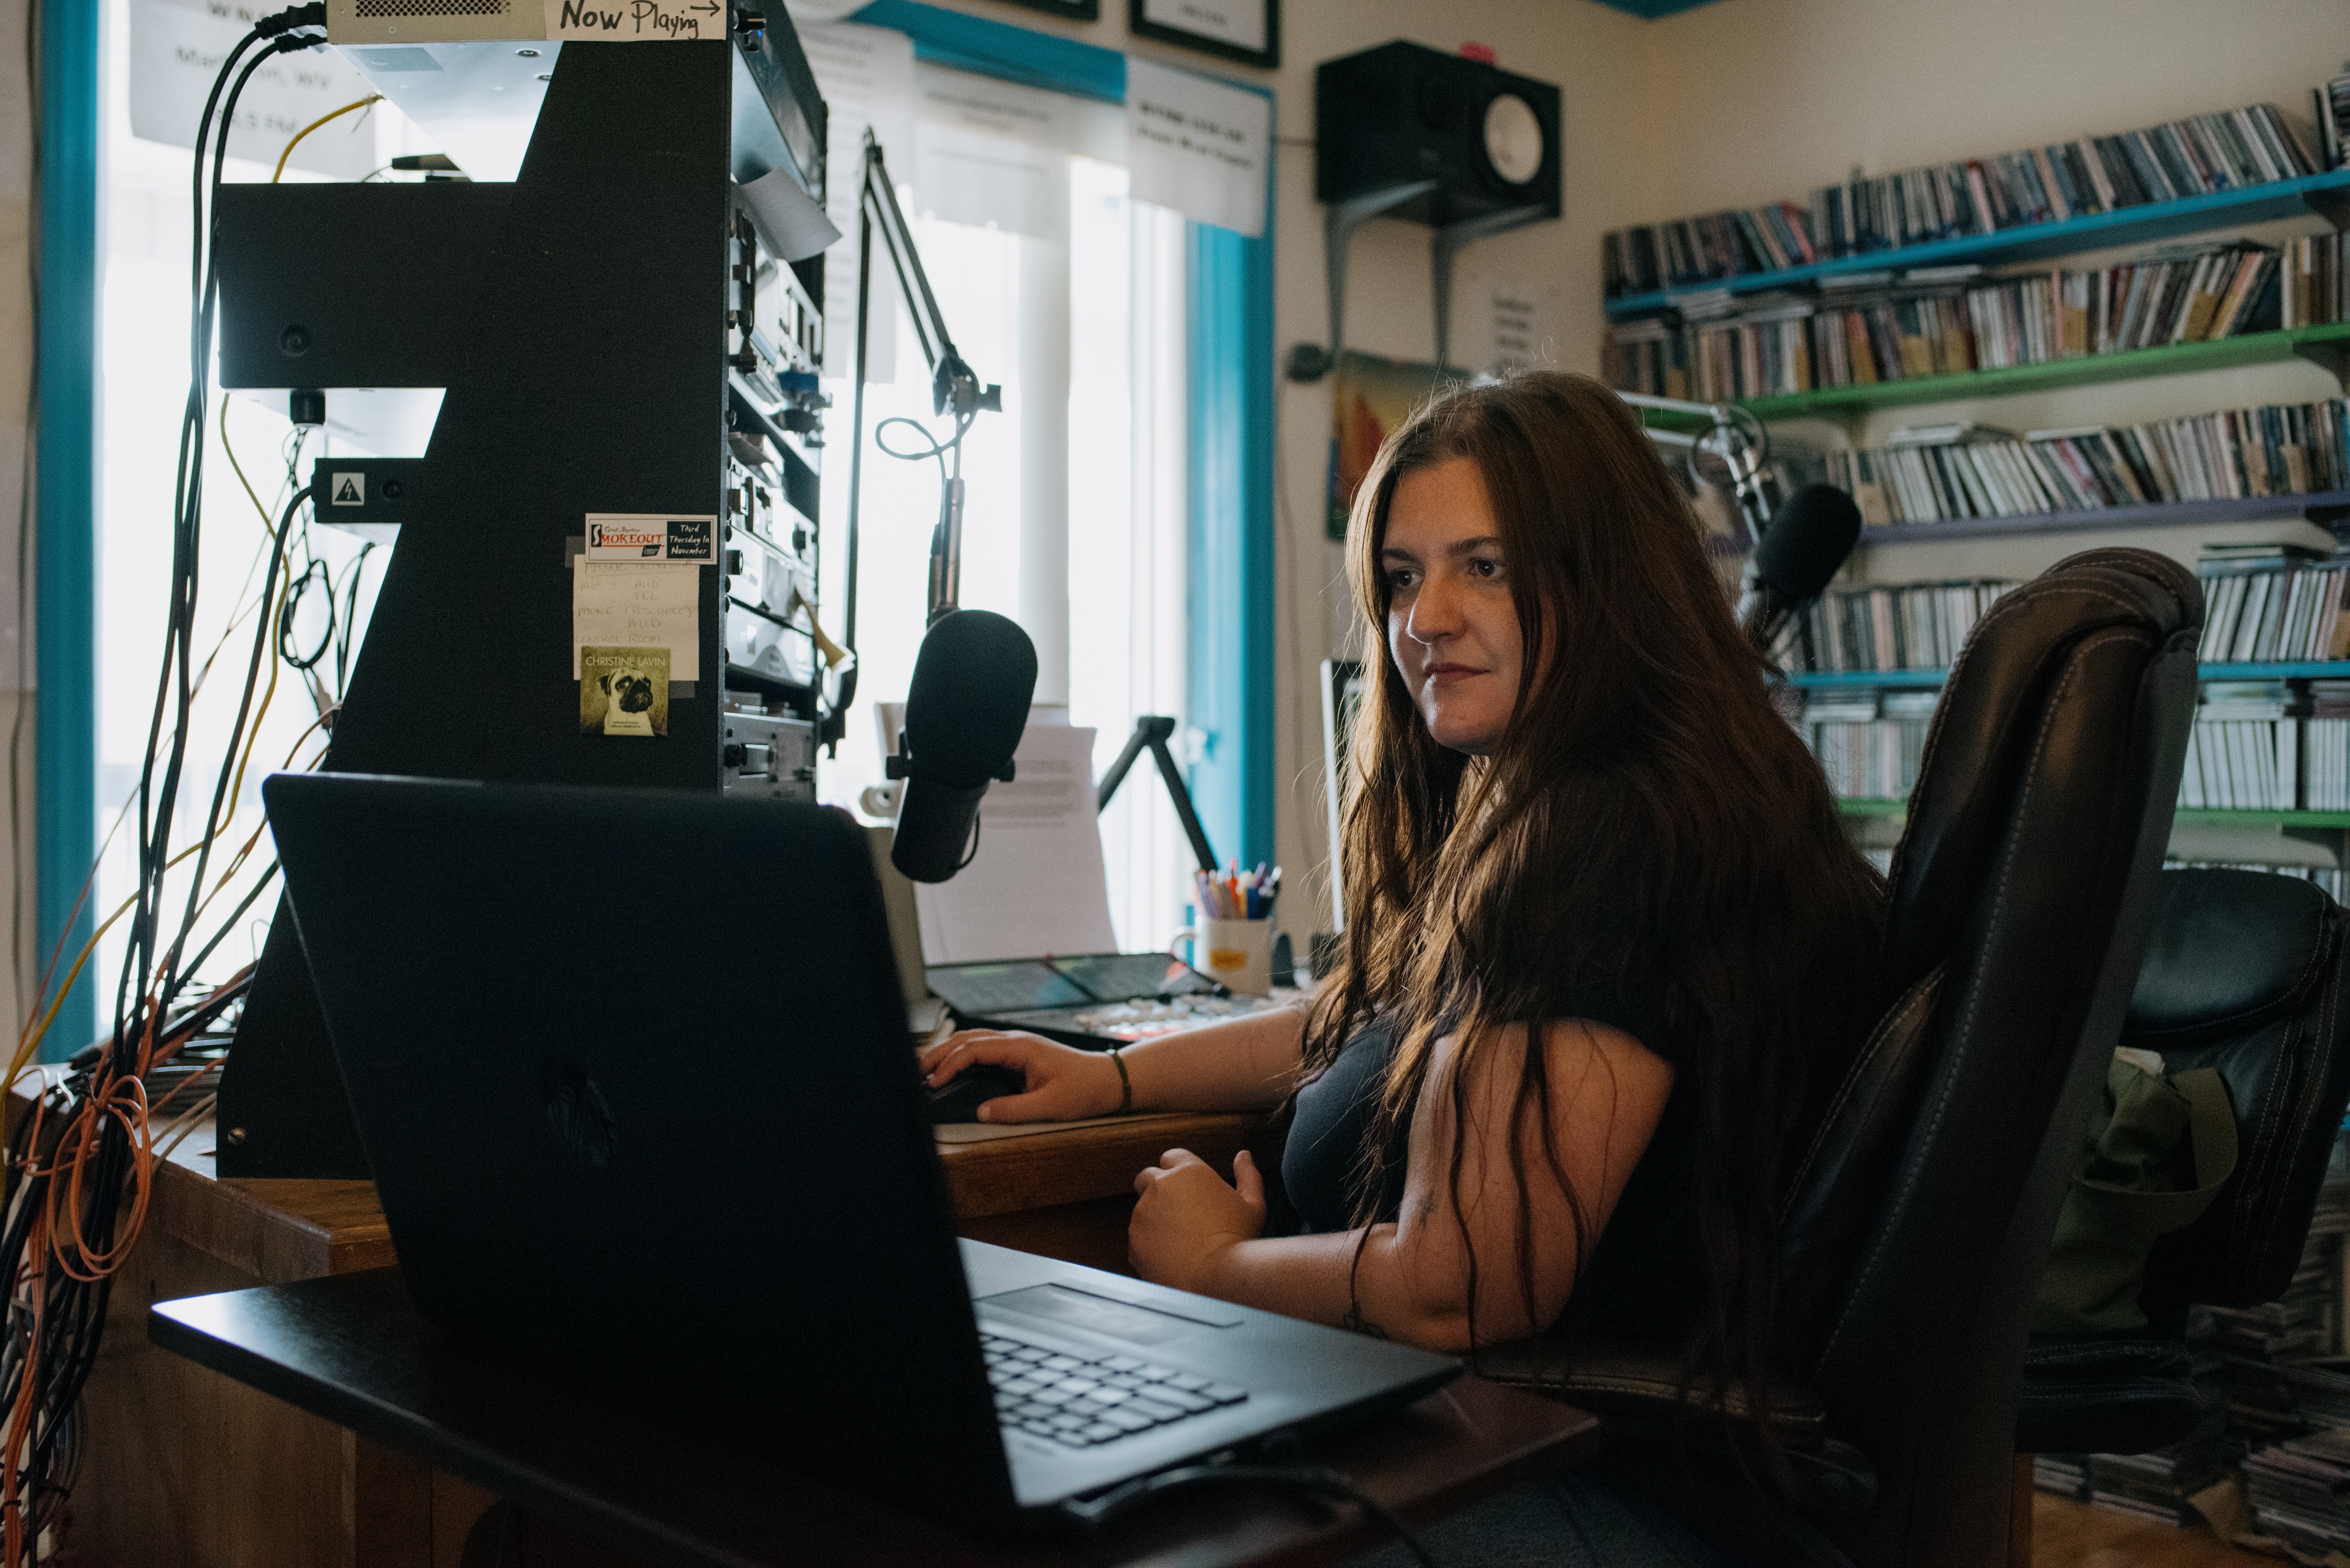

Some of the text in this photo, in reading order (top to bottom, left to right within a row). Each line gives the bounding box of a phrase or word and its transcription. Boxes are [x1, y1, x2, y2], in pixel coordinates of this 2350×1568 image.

[560, 0, 699, 40] Now Playing
[680, 524, 699, 533] Third
[593, 525, 665, 546] SMOKEOUT
[669, 535, 701, 545] Thursday
[585, 656, 666, 667] CHRISTINE LAVIN
